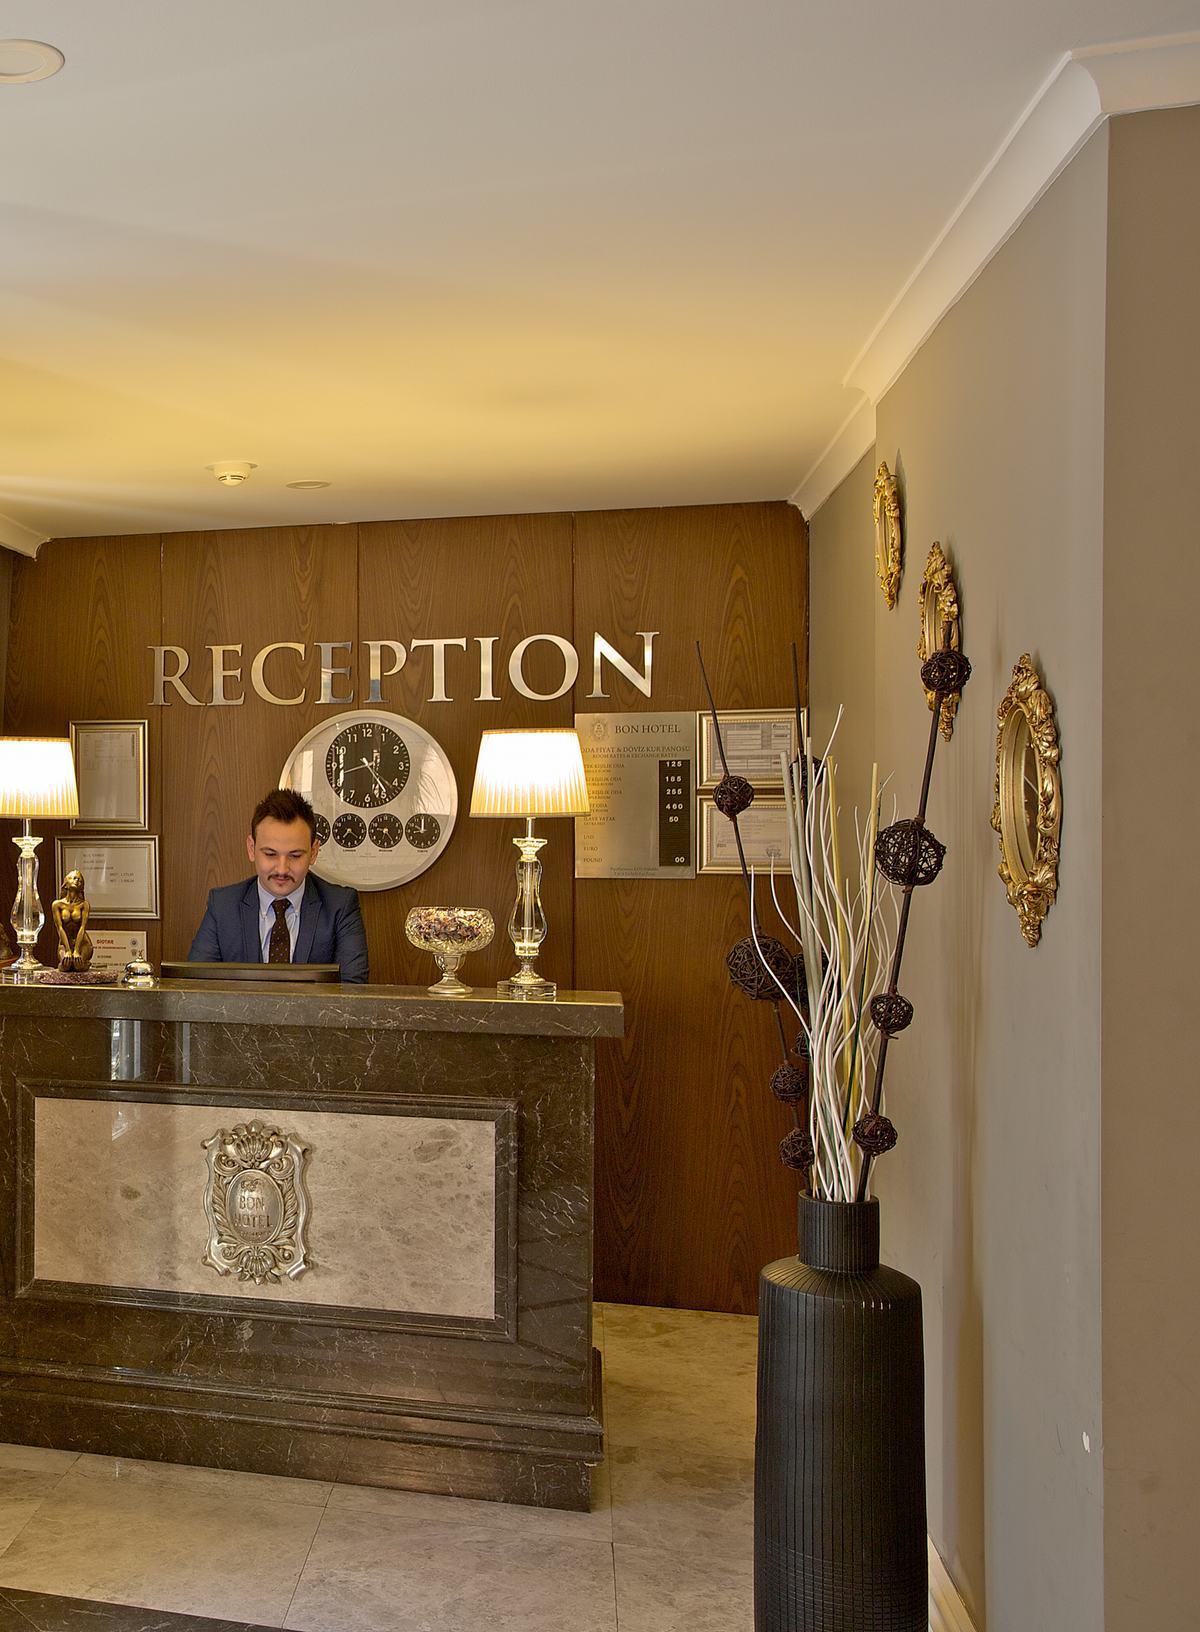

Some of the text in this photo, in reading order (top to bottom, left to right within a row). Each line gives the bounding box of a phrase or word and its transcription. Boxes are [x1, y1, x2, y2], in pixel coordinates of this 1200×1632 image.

[147, 631, 658, 706] RECEPTION
[362, 728, 373, 738] 12
[615, 724, 681, 734] BON HOTEL
[347, 733, 358, 743] 11
[381, 733, 386, 742] 1
[393, 745, 400, 755] 2
[398, 761, 405, 771] 3
[392, 777, 399, 787] 4
[349, 789, 355, 799] 7
[364, 793, 371, 803] 6
[239, 1197, 264, 1209] BON
[234, 1214, 273, 1228] HOTEL
